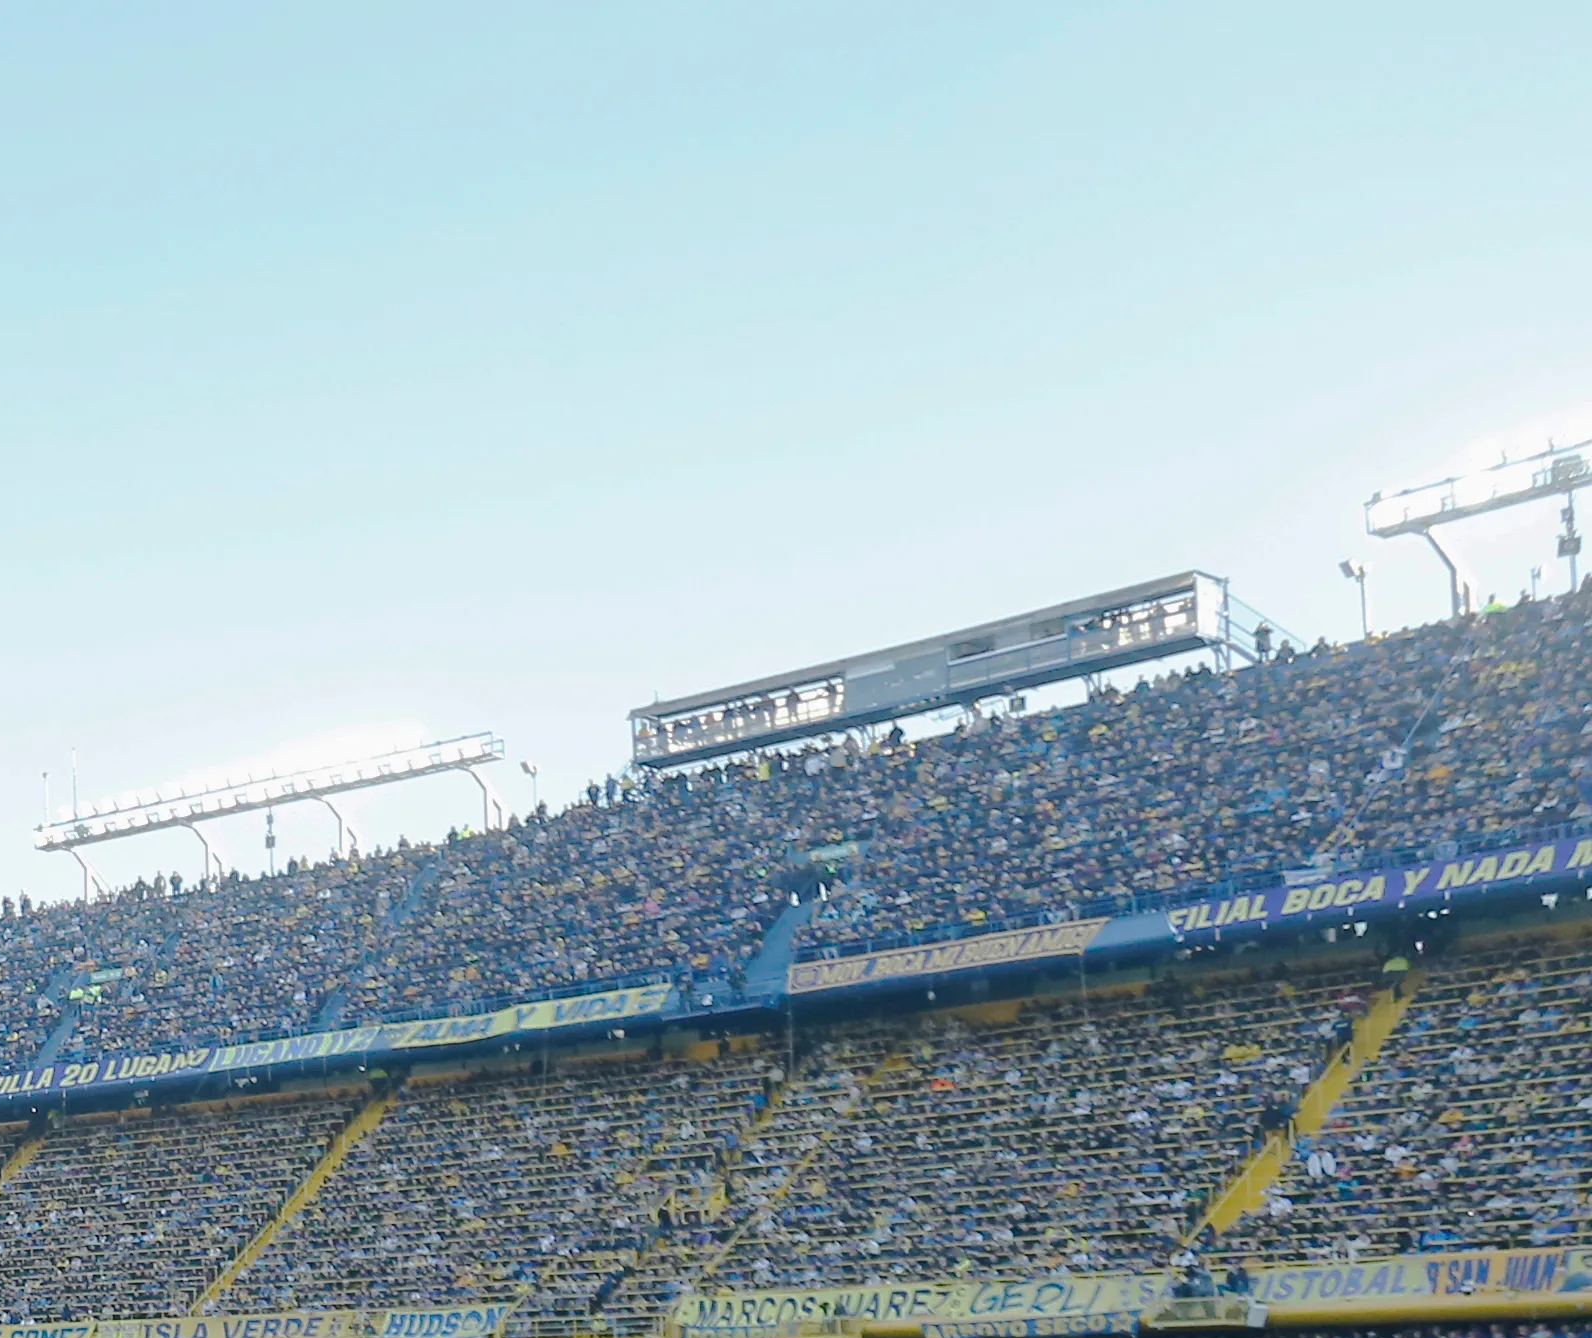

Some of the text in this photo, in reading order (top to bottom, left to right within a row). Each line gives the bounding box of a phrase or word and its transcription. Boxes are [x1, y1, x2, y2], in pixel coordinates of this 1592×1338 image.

[1169, 893, 1269, 932] FILIAL
[1280, 875, 1387, 915] BOCA
[1401, 868, 1430, 896] Y
[1436, 845, 1556, 890] NADA
[59, 1060, 101, 1088] 20
[101, 1047, 210, 1081] LUGANO
[1247, 1264, 1407, 1300] ISTOBAL
[385, 1305, 508, 1337] HUDSON
[697, 1295, 816, 1326] MARCOS
[1035, 1315, 1108, 1336] SECO
